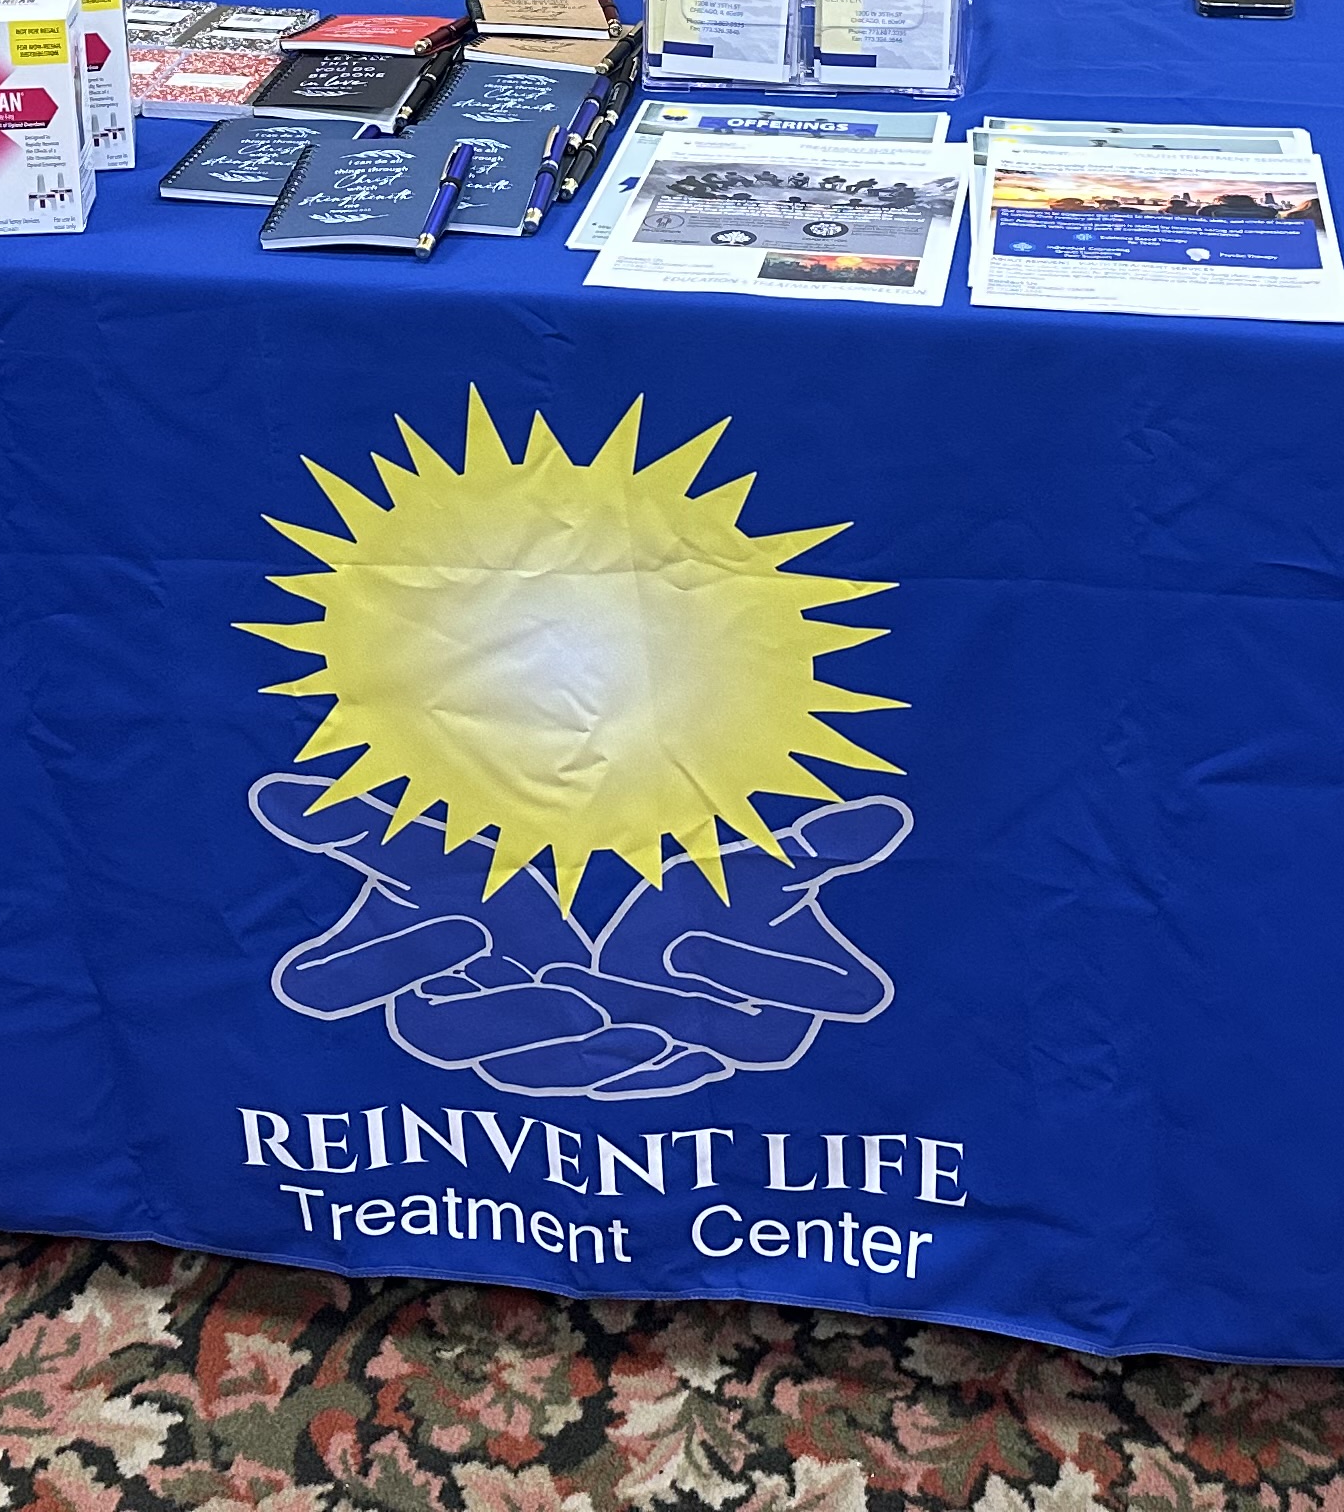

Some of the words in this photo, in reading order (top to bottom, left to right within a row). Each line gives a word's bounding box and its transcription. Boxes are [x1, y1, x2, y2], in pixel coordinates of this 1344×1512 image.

[727, 118, 849, 132] OFFERINGS
[664, 276, 738, 284] EDUCATION
[236, 1103, 735, 1196] REINVENT
[763, 1132, 968, 1208] LIFE
[279, 1183, 632, 1264] Treatment
[692, 1204, 934, 1279] Center
